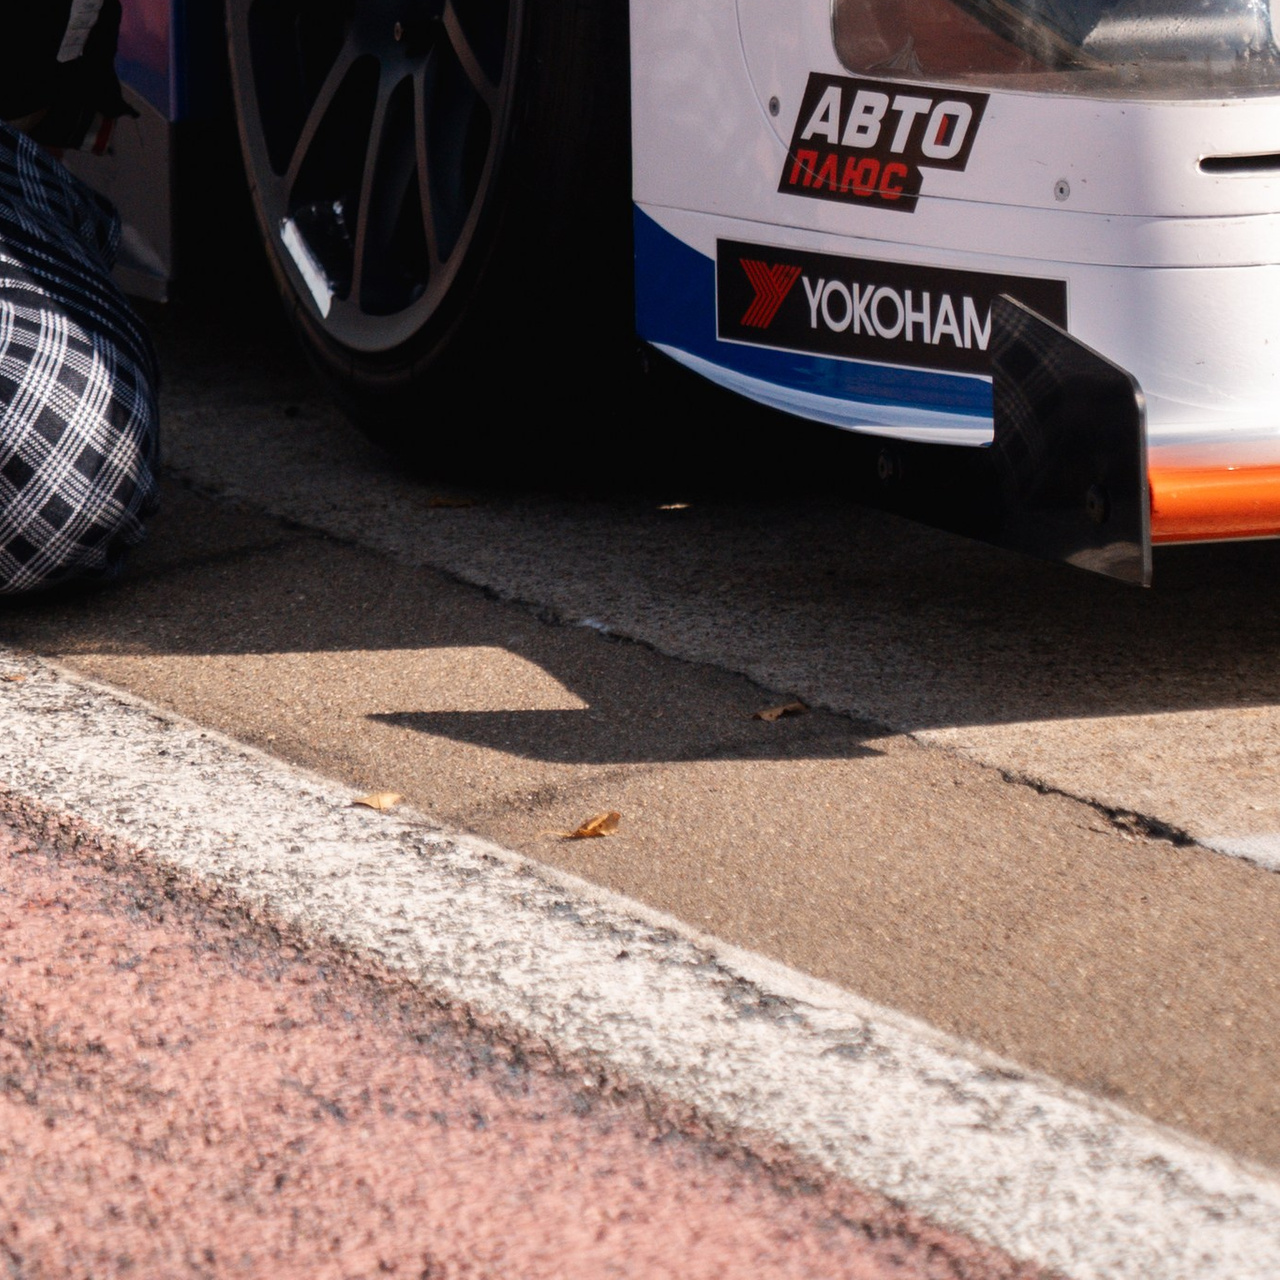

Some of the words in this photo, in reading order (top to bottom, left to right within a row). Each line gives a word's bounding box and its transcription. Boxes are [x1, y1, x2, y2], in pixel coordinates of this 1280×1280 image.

[800, 85, 973, 160] АВТО
[789, 148, 908, 200] ПЛЮС
[802, 276, 992, 351] YOKOHAM
